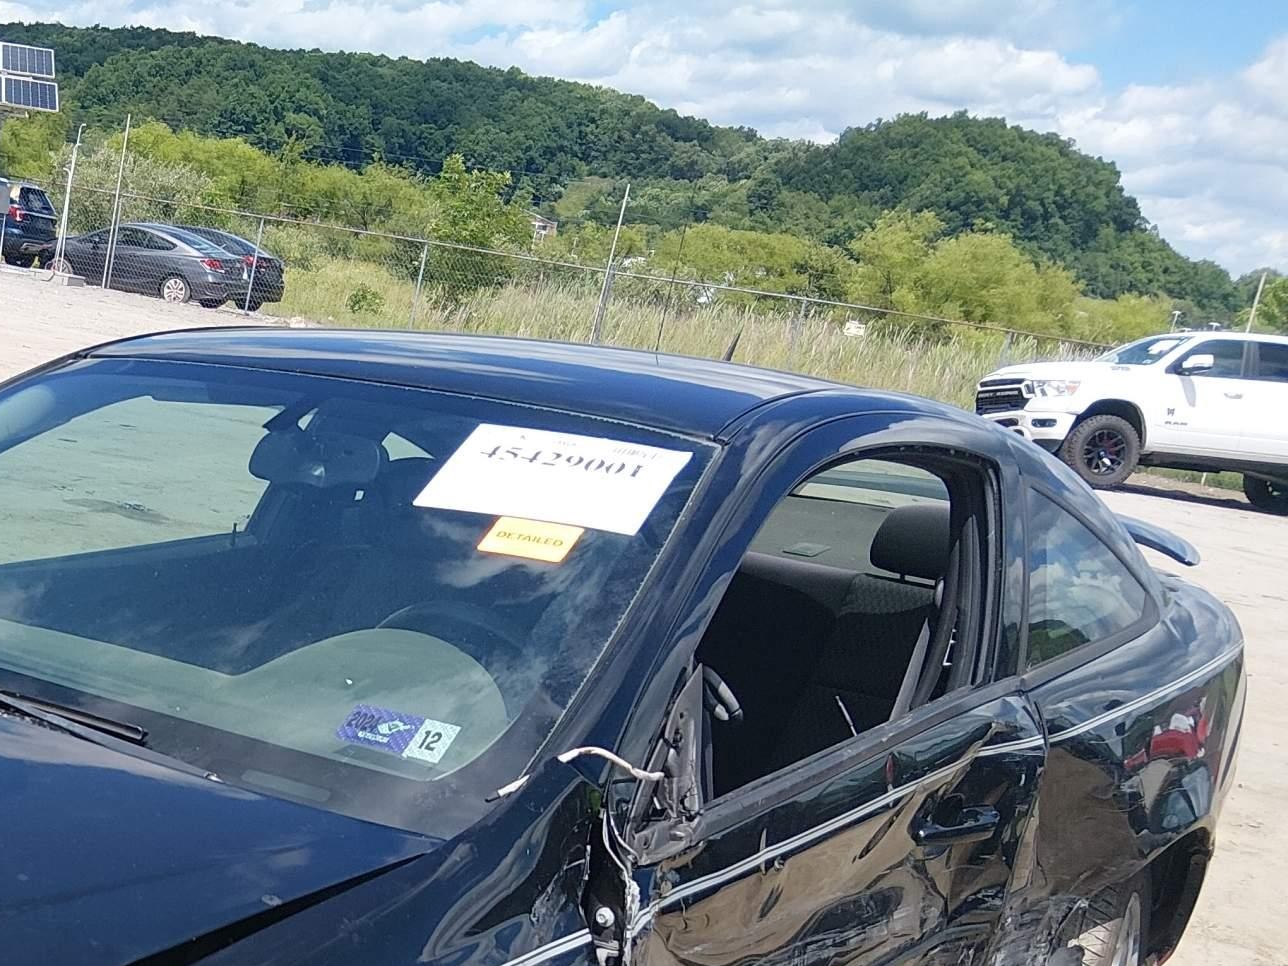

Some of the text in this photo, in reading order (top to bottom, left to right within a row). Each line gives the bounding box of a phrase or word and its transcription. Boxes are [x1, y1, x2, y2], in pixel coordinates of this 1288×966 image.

[480, 444, 644, 478] 45429001
[495, 529, 564, 548] DETAILED
[418, 730, 443, 751] 12
